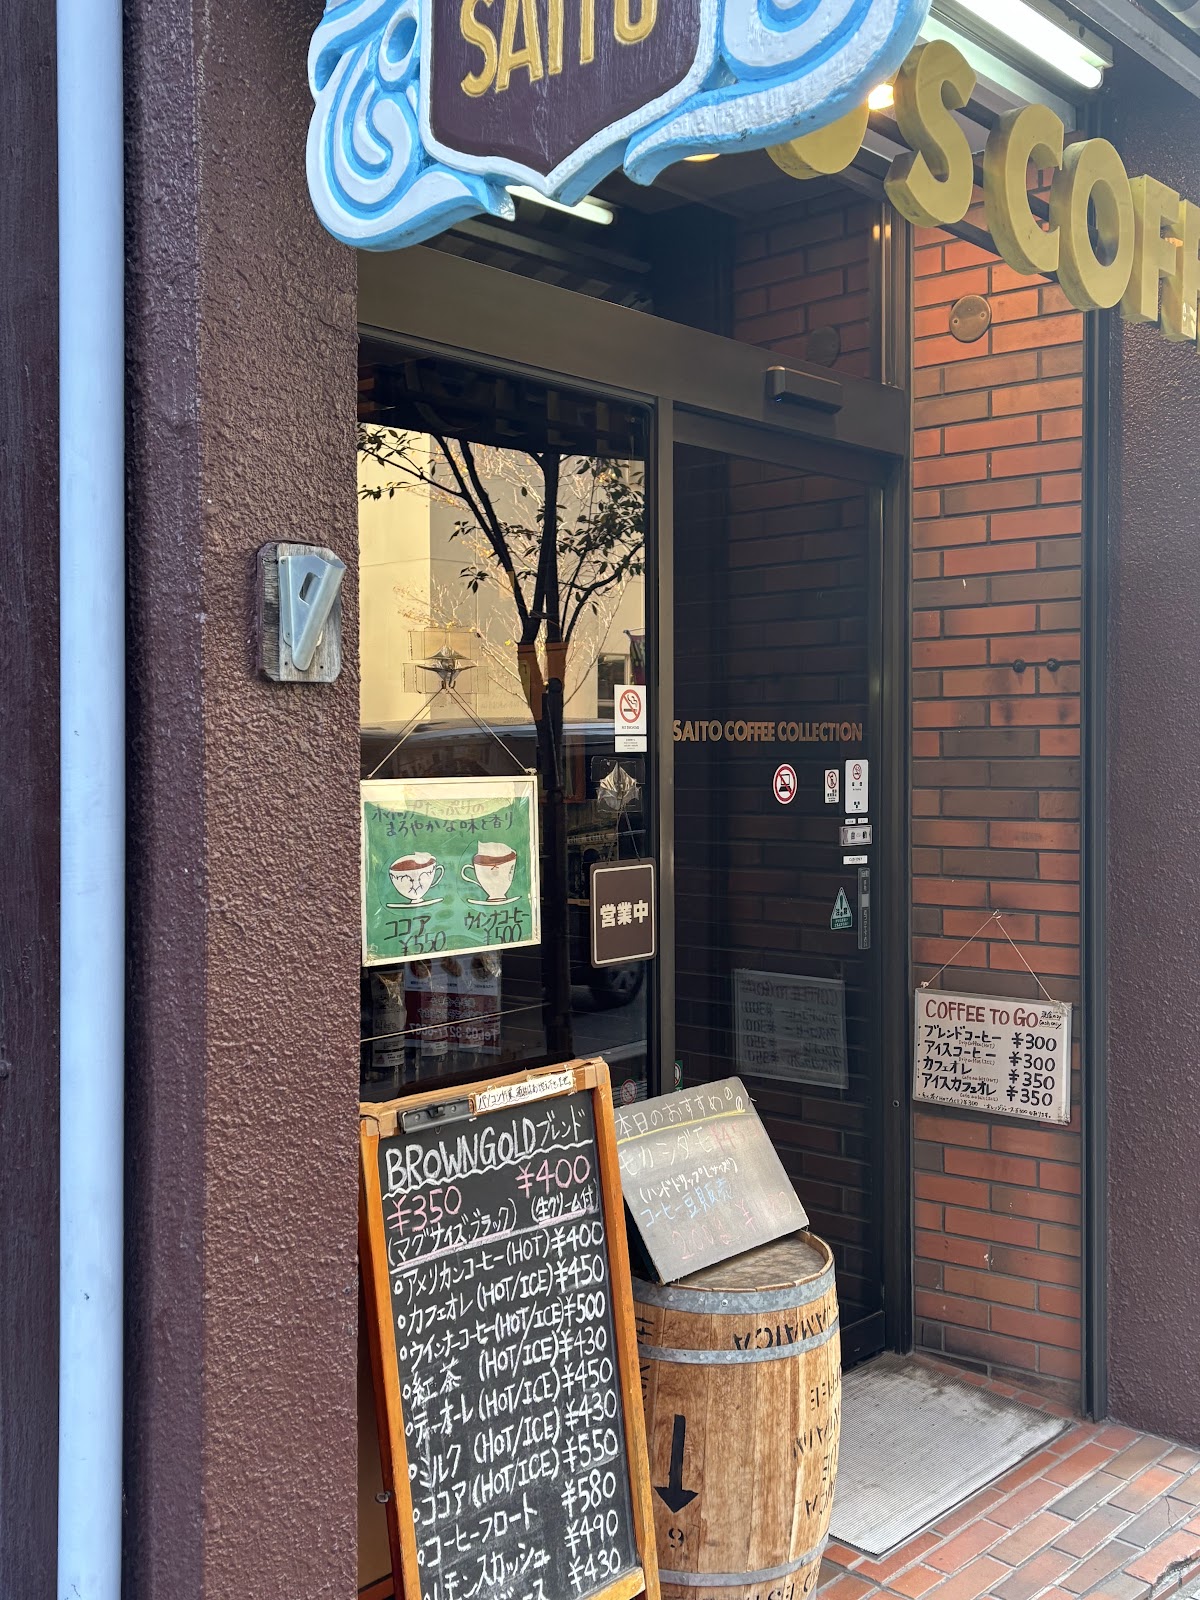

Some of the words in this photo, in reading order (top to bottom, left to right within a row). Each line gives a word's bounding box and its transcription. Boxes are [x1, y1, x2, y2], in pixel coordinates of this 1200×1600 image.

[672, 719, 722, 742] SAITO
[724, 720, 775, 742] COFFEE
[777, 721, 862, 742] COLLECTION
[386, 811, 514, 837] まろやかな味と香り
[384, 915, 431, 940] ココア
[600, 899, 649, 928] 営業中
[398, 931, 447, 957] ¥550
[926, 999, 985, 1023] COFFEE
[989, 1008, 1010, 1025] TO
[1013, 1007, 1039, 1028] GO
[924, 1025, 1002, 1042] ブレンドコーヒー
[1011, 1032, 1057, 1052] ¥300
[924, 1040, 997, 1059] アイスコーヒー
[1008, 1051, 1056, 1072] ¥300
[922, 1073, 997, 1095] アイスカフェオレ
[1006, 1085, 1053, 1107] ¥350
[923, 1056, 973, 1075] カフェオレ
[1008, 1069, 1055, 1090] ¥350
[614, 1094, 724, 1140] 本日のおすすめ
[515, 1154, 591, 1199] ¥400
[386, 1185, 462, 1236] ¥350
[551, 1221, 604, 1259] ¥400
[406, 1292, 474, 1337] カフェオレ
[477, 1262, 553, 1312] (HOT/ICE)
[554, 1254, 604, 1293] ¥450
[563, 1290, 606, 1327] ¥500
[479, 1330, 559, 1382] (HOT/ICE)
[558, 1325, 607, 1362] ¥430
[479, 1366, 560, 1421] (HOT/ICE)
[561, 1357, 613, 1395] ¥450
[419, 1444, 461, 1488] ミルク
[474, 1406, 560, 1463] (HOT/ICE)
[565, 1389, 617, 1432] ¥430
[421, 1480, 467, 1526] ココア
[472, 1446, 560, 1509] (HOT/ICE)
[561, 1428, 618, 1473] ¥550
[425, 1492, 538, 1568] コーヒーフロート
[561, 1470, 616, 1518] ¥580
[564, 1509, 619, 1557] ¥490
[567, 1548, 621, 1593] ¥430
